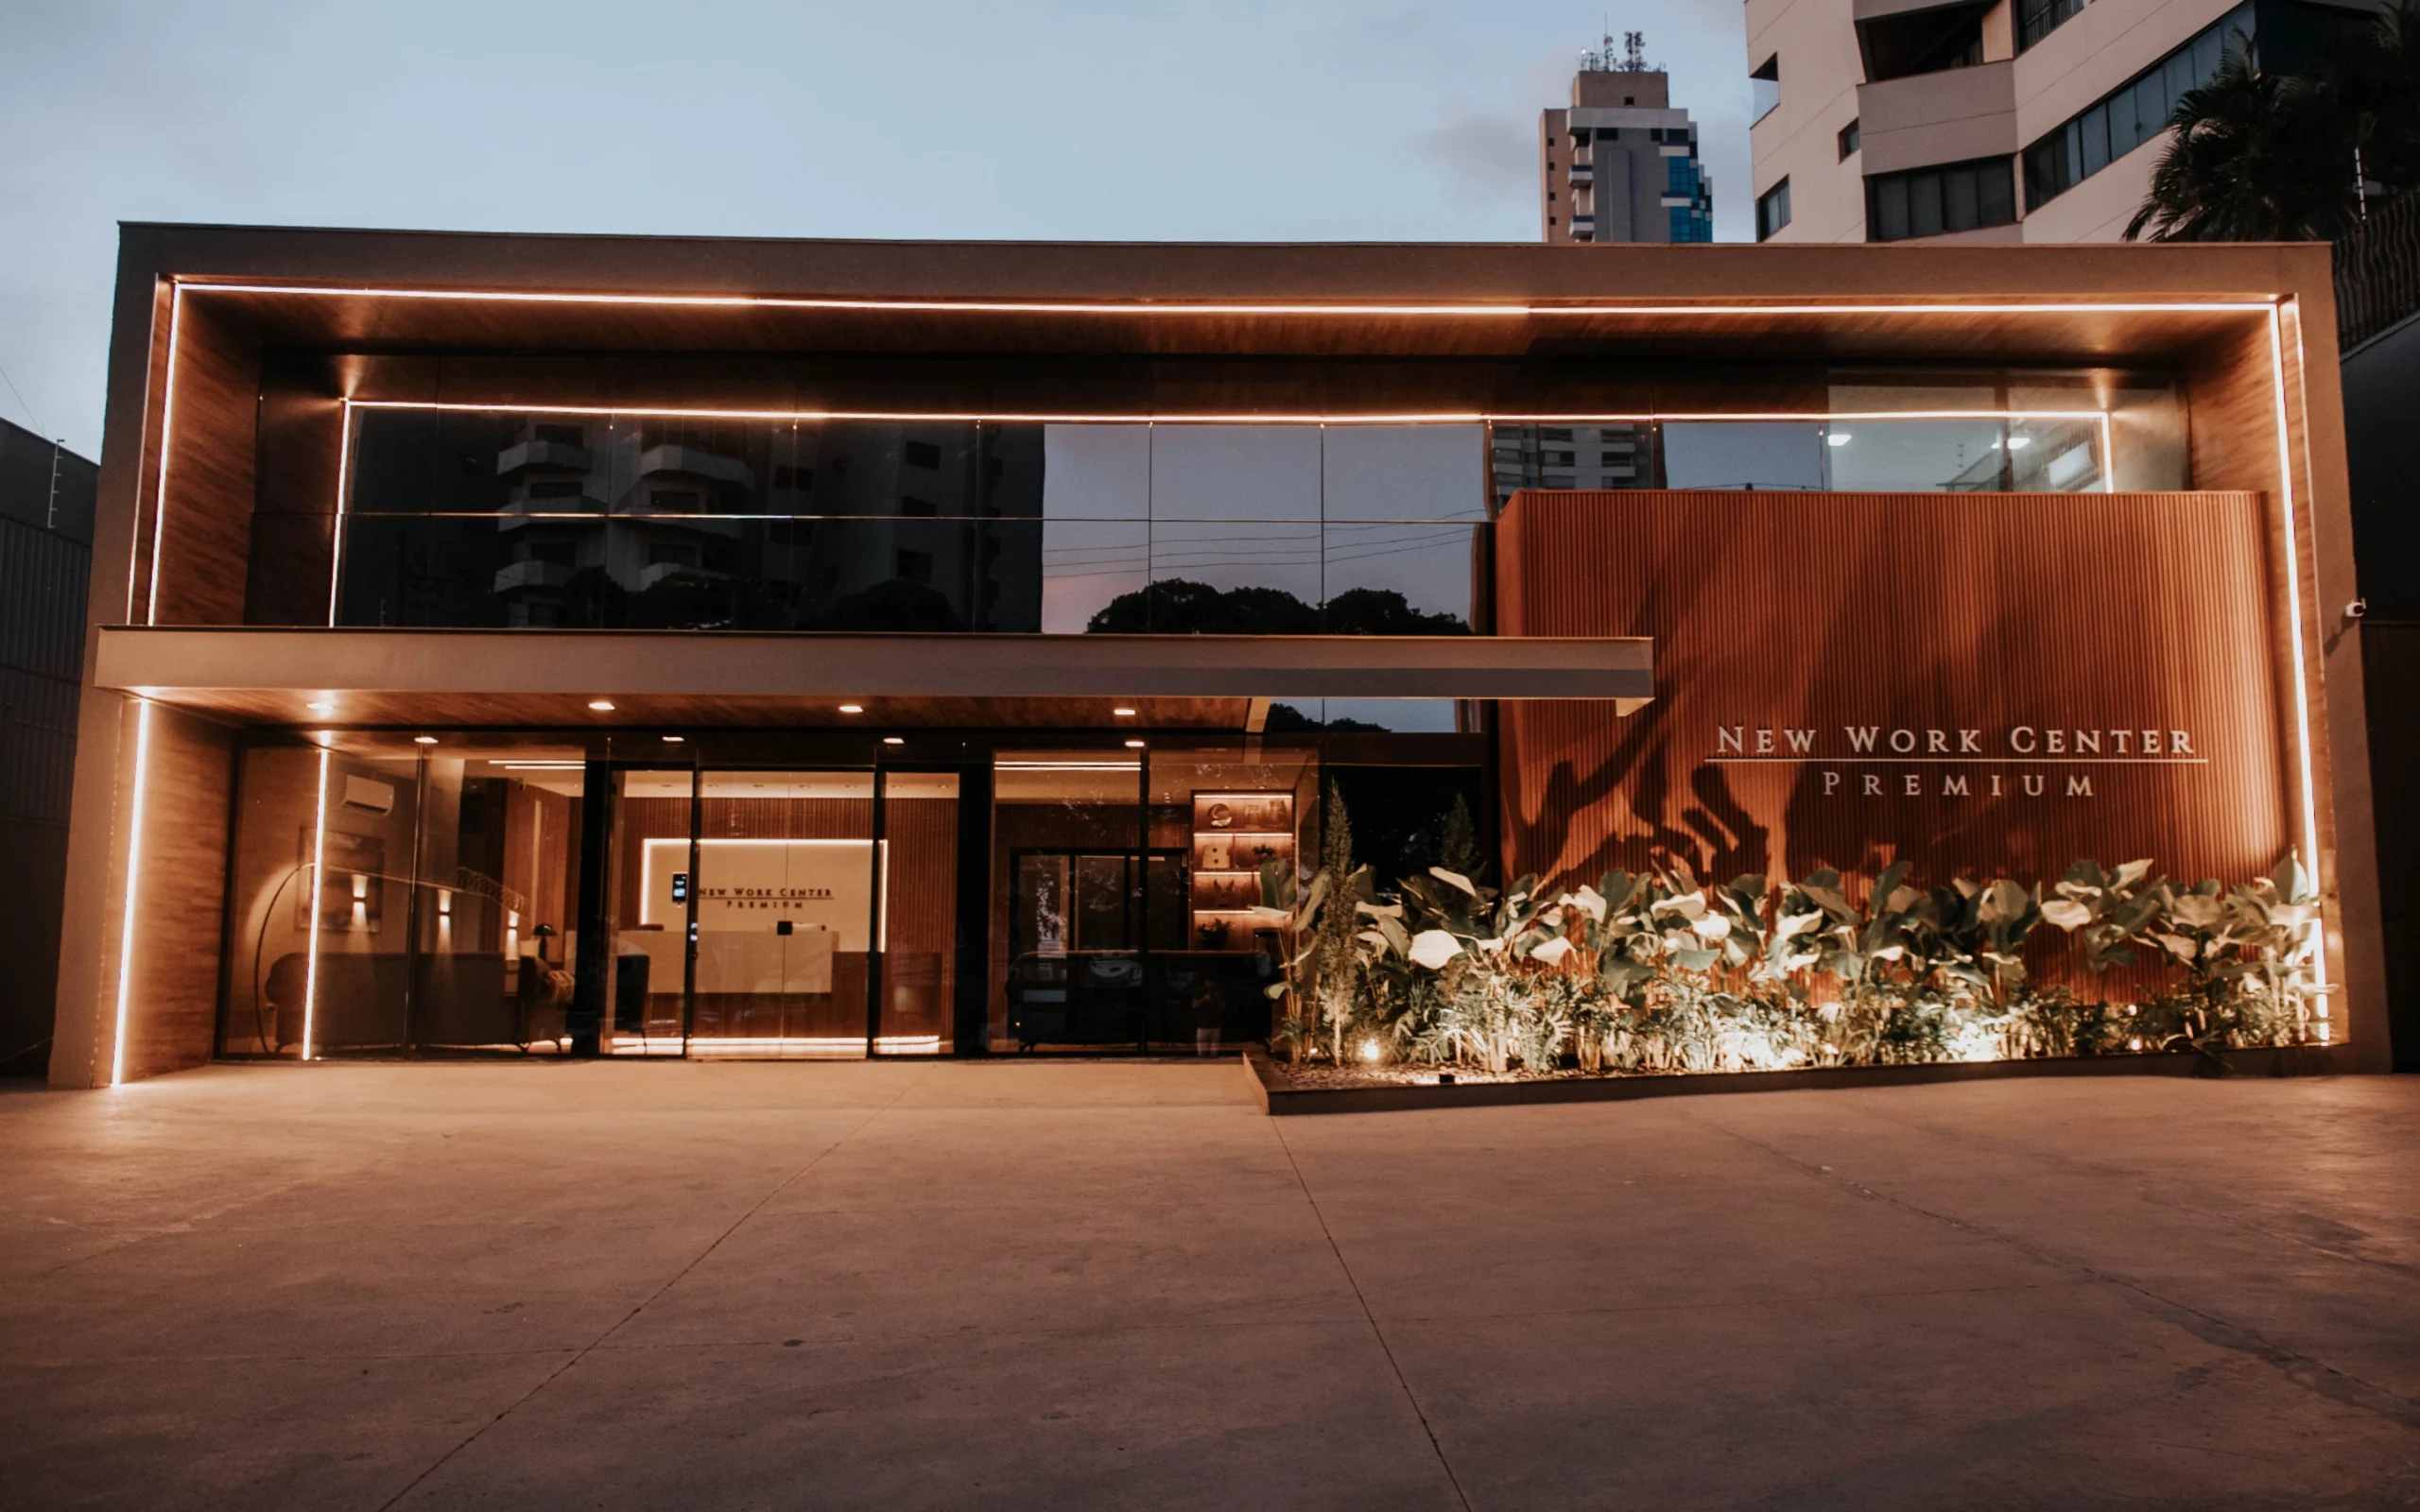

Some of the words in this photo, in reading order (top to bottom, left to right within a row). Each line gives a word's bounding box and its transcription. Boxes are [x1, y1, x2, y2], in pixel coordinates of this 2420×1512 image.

[1717, 726, 1817, 753] NEW
[1844, 726, 1982, 753] WORK
[2010, 726, 2195, 754] CENTER
[1823, 771, 2095, 797] PREMIUM
[734, 887, 773, 897] WORK
[780, 887, 832, 897] CENTER
[726, 901, 804, 909] PREMIUM
